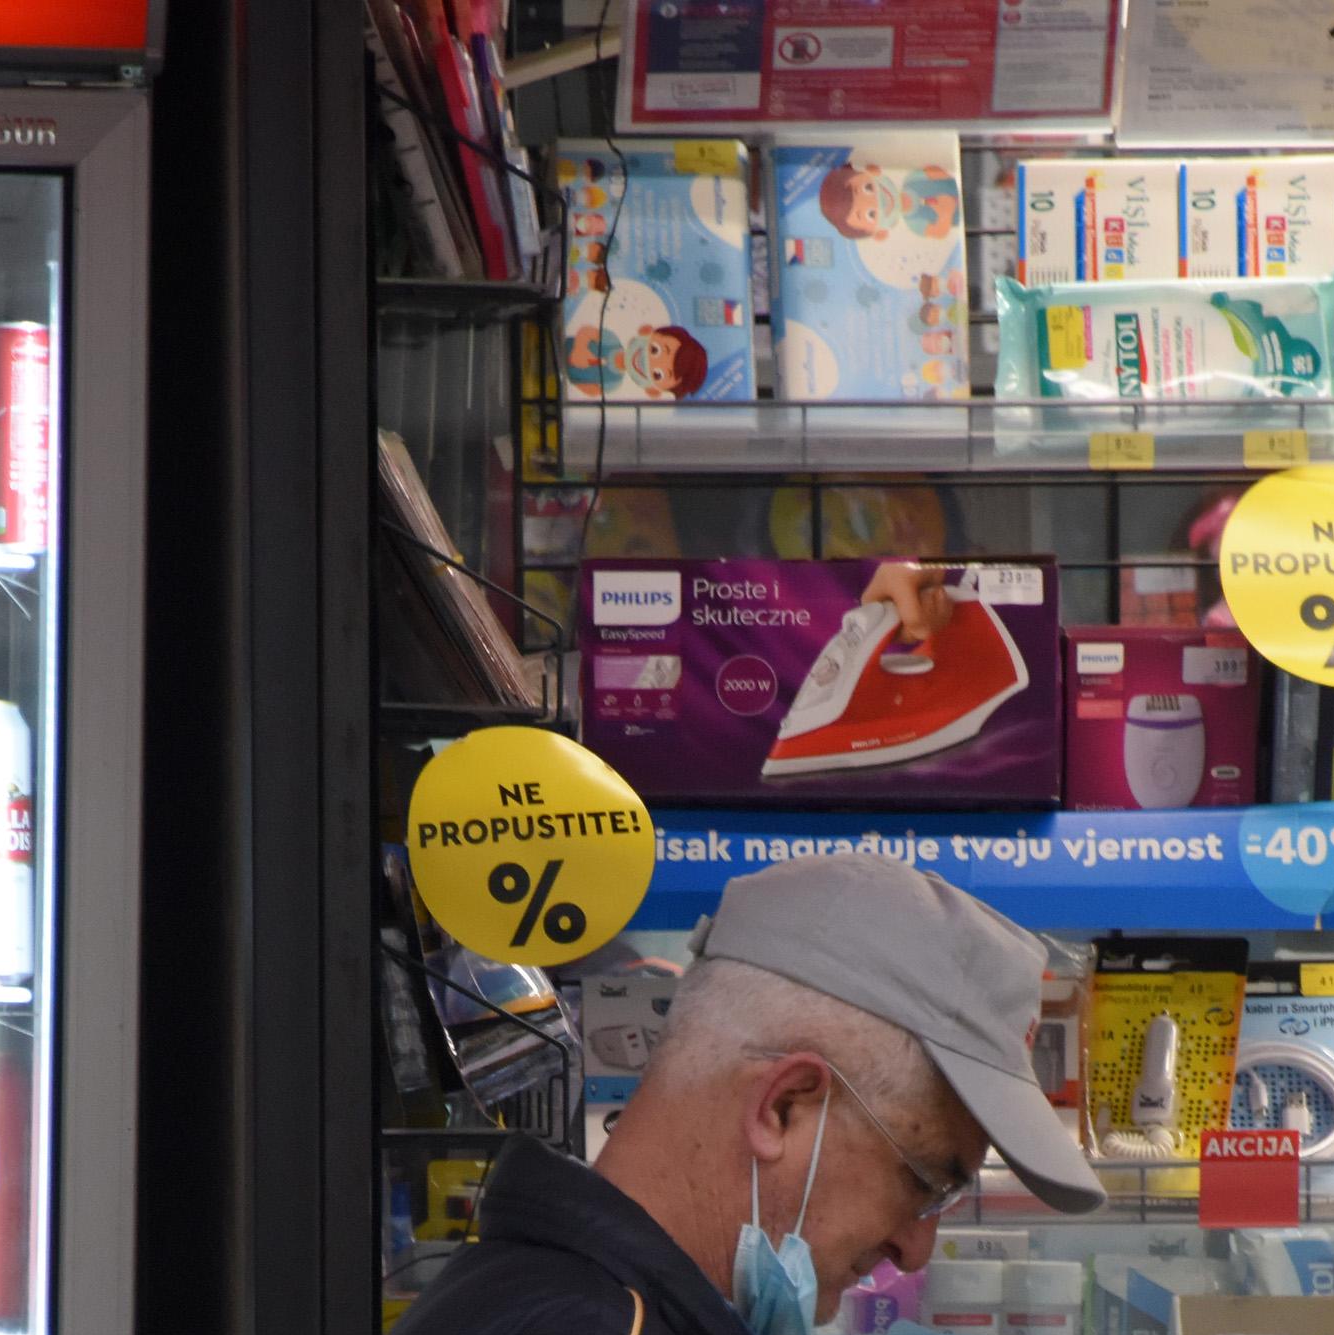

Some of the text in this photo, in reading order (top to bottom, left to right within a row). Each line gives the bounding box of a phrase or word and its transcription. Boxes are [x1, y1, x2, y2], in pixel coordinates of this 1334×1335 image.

[1030, 189, 1055, 213] 10
[1192, 188, 1217, 212] 10
[1116, 312, 1141, 397] NYTOL
[601, 590, 674, 608] PHILIPS
[691, 577, 780, 601] Proste i
[691, 606, 812, 628] skuteczne
[600, 627, 667, 643] EasySpeed
[723, 678, 771, 693] 2000 W
[498, 782, 545, 807] NE
[417, 810, 643, 849] PROPUSTITE!
[655, 826, 732, 861] isak
[950, 833, 1052, 870] tvoju
[1063, 830, 1223, 870] vjernost
[1244, 1002, 1274, 1014] kabel
[1275, 1004, 1289, 1014] za
[1204, 1136, 1296, 1158] AKCIJA
